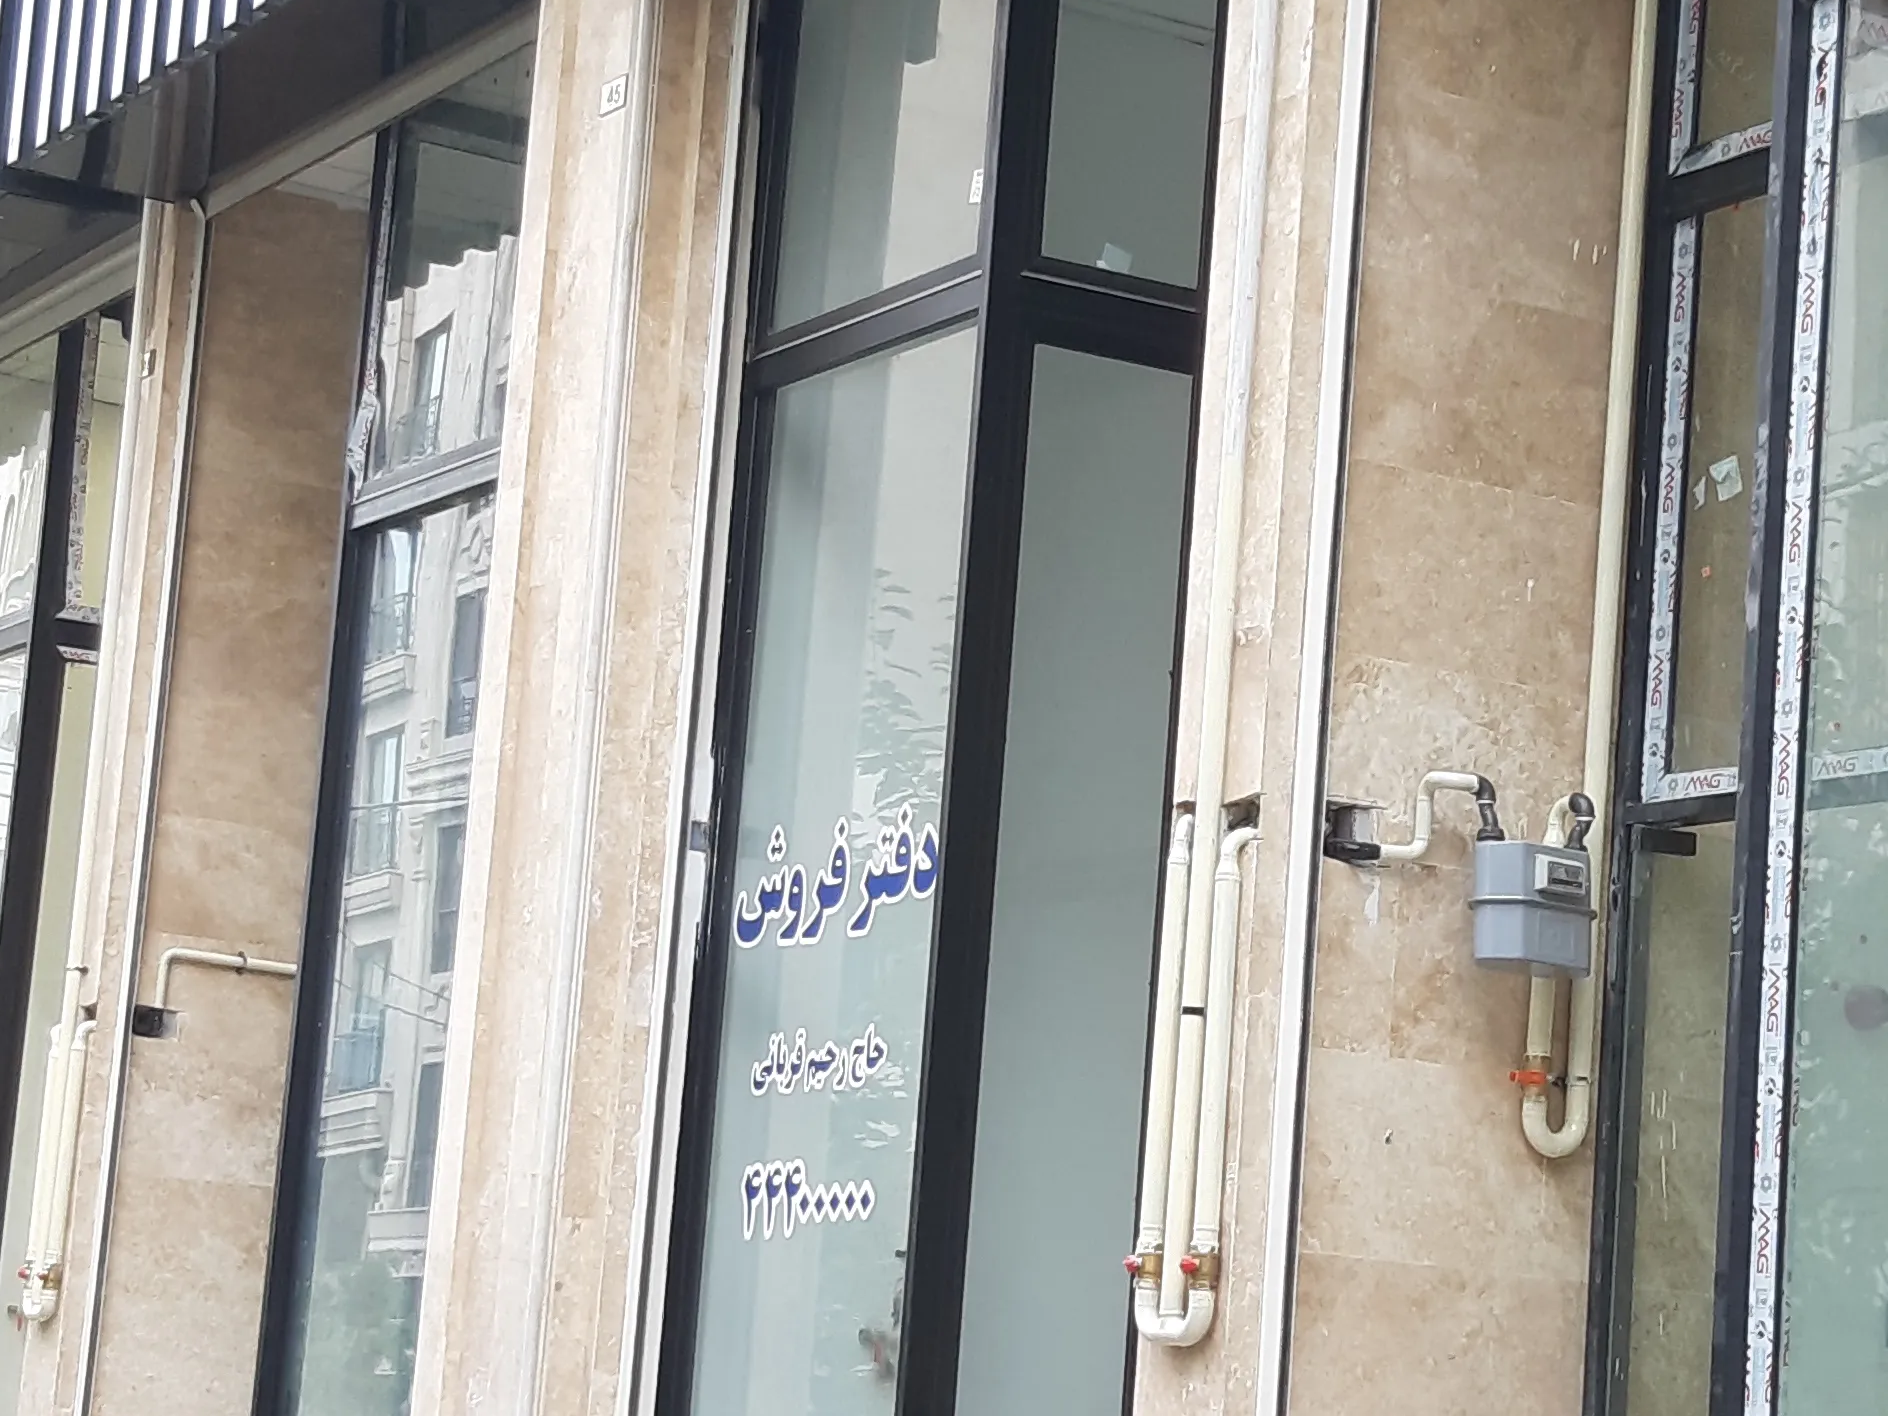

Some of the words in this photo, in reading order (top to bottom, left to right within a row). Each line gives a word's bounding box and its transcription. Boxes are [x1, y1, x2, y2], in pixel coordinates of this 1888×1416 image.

[1674, 273, 1687, 322] MAG
[1799, 274, 1818, 334] MAG
[1662, 463, 1675, 514] MAG
[1788, 503, 1804, 563] MAG
[1651, 654, 1664, 706] MAG
[1776, 733, 1791, 797] MAG
[1817, 756, 1858, 777] MAG
[733, 816, 850, 948] فروش
[847, 801, 939, 937] دفتر
[1766, 968, 1780, 1035] MAG
[751, 1027, 806, 1096] قربانی
[804, 1040, 849, 1092] رحیم
[848, 1022, 888, 1088] حاج
[741, 1158, 875, 1241] ۴۴۴۰۰۰۰۰
[1757, 1209, 1771, 1275] MAG
